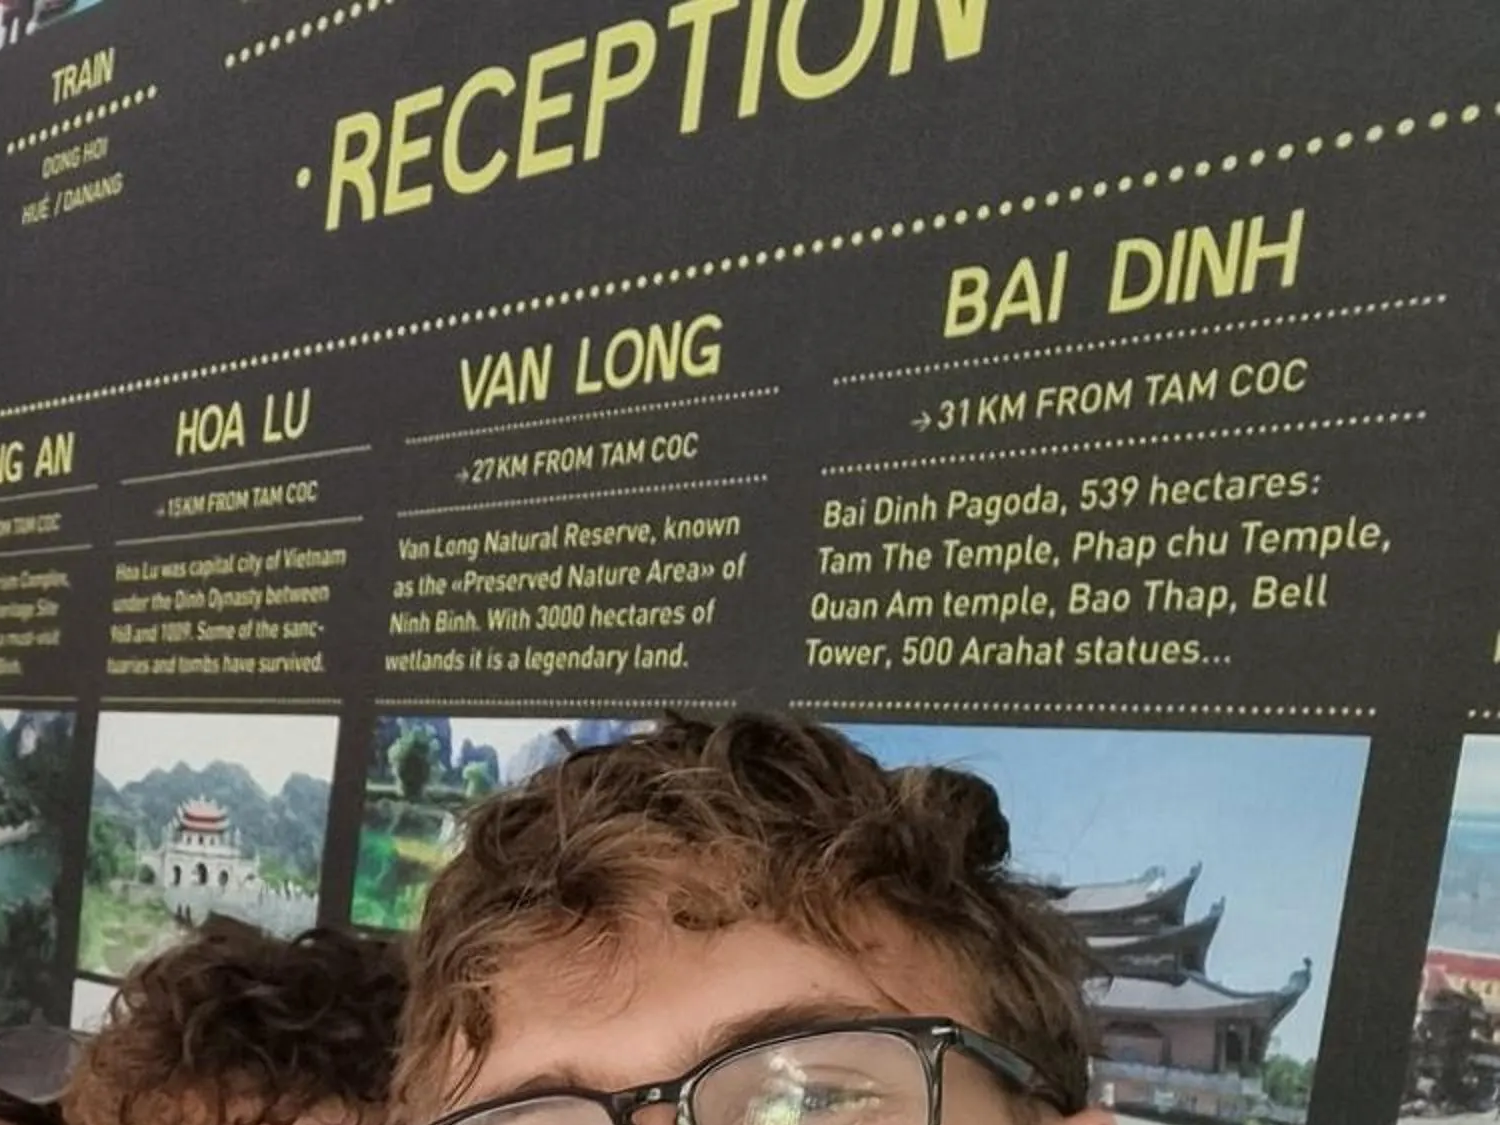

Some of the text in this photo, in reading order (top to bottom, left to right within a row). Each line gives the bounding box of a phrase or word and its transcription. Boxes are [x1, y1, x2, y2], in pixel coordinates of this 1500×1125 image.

[51, 47, 116, 104] TRAIN
[325, 0, 990, 232] RECEPTION
[943, 208, 1305, 338] BAI DINH
[461, 314, 723, 411] VAN LONG
[1036, 378, 1133, 418] FROM
[1145, 368, 1218, 406] TAM
[1229, 358, 1308, 397] COC
[176, 387, 311, 456] HOA LU
[34, 431, 76, 478] AN
[533, 445, 594, 476] FROM
[601, 438, 646, 467] TAM
[650, 431, 699, 463] COC
[207, 489, 250, 514] FROM
[252, 485, 284, 509] TAM
[285, 480, 319, 505] COC
[822, 470, 1322, 529] Bai Dinh Pagoda, 539 hectares:
[397, 514, 741, 563] Van Long Natural Reserve, known
[818, 515, 1392, 576] Tam The Temple, Phap chu Temple,
[142, 560, 158, 581] Lu
[189, 554, 235, 580] capital
[236, 553, 263, 577] city
[265, 549, 282, 571] of
[282, 547, 348, 570] Vietnam
[393, 581, 414, 598] as
[418, 573, 447, 597] the
[567, 561, 641, 589] Nature
[721, 551, 748, 580] of
[265, 583, 331, 606] between
[389, 597, 717, 635] Ninh Binh. With 3000 hectares of
[810, 571, 1329, 624] Quan Am temple, Bao Thap, Bell
[197, 619, 236, 641] Some
[238, 617, 254, 640] of
[255, 618, 279, 640] the
[805, 633, 1232, 671] Tower, 500 Arahat statues...
[222, 653, 255, 674] have
[385, 641, 690, 677] wetlands it is a legendary land.
